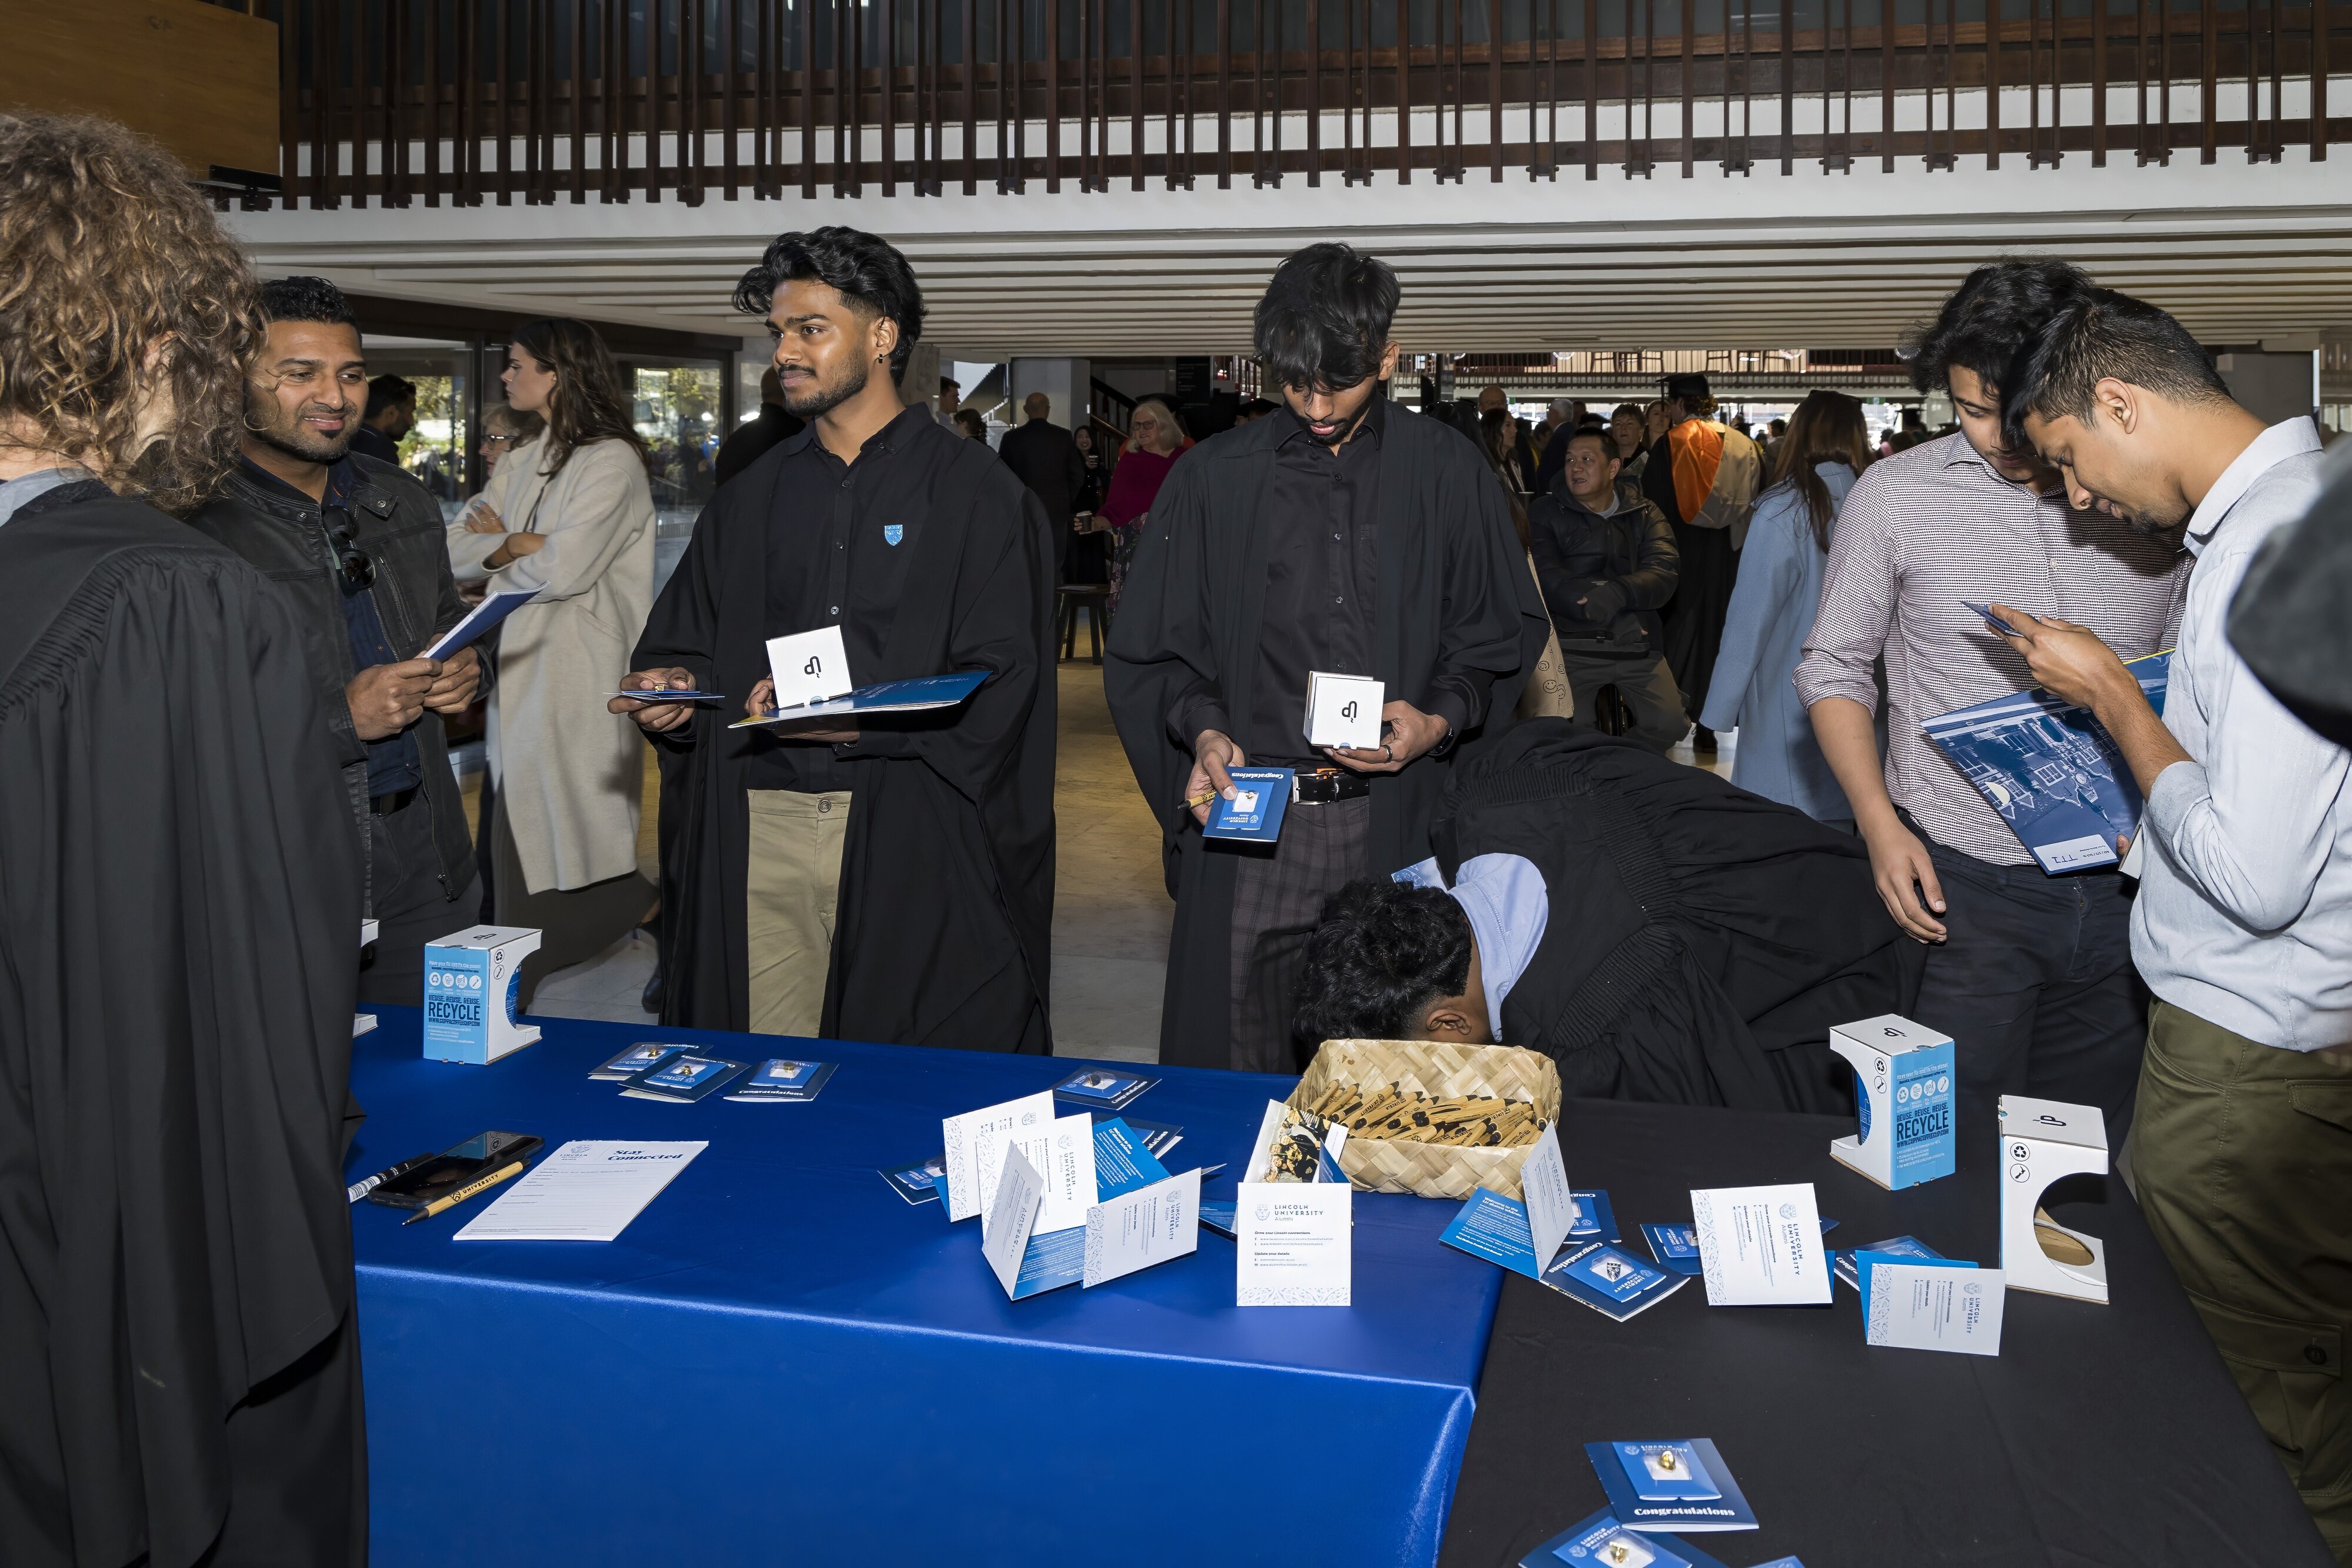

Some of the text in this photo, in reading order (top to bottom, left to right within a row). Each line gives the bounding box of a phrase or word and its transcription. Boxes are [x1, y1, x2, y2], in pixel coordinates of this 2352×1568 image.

[429, 1002, 481, 1020] RECYCLE
[1896, 1110, 1949, 1142] RECYCLE
[462, 1173, 499, 1195] UNIVERSITY
[1064, 1153, 1072, 1201] UNIVERSITY
[1787, 1224, 1800, 1275] UNIVERSITY
[1793, 1223, 1803, 1259] LINCOLN
[1548, 1242, 1603, 1274] Congratulations
[1634, 1507, 1736, 1516] Congratulations
[1580, 1527, 1607, 1546] LINCOLN
[1585, 1524, 1620, 1548] UNIVERSITY
